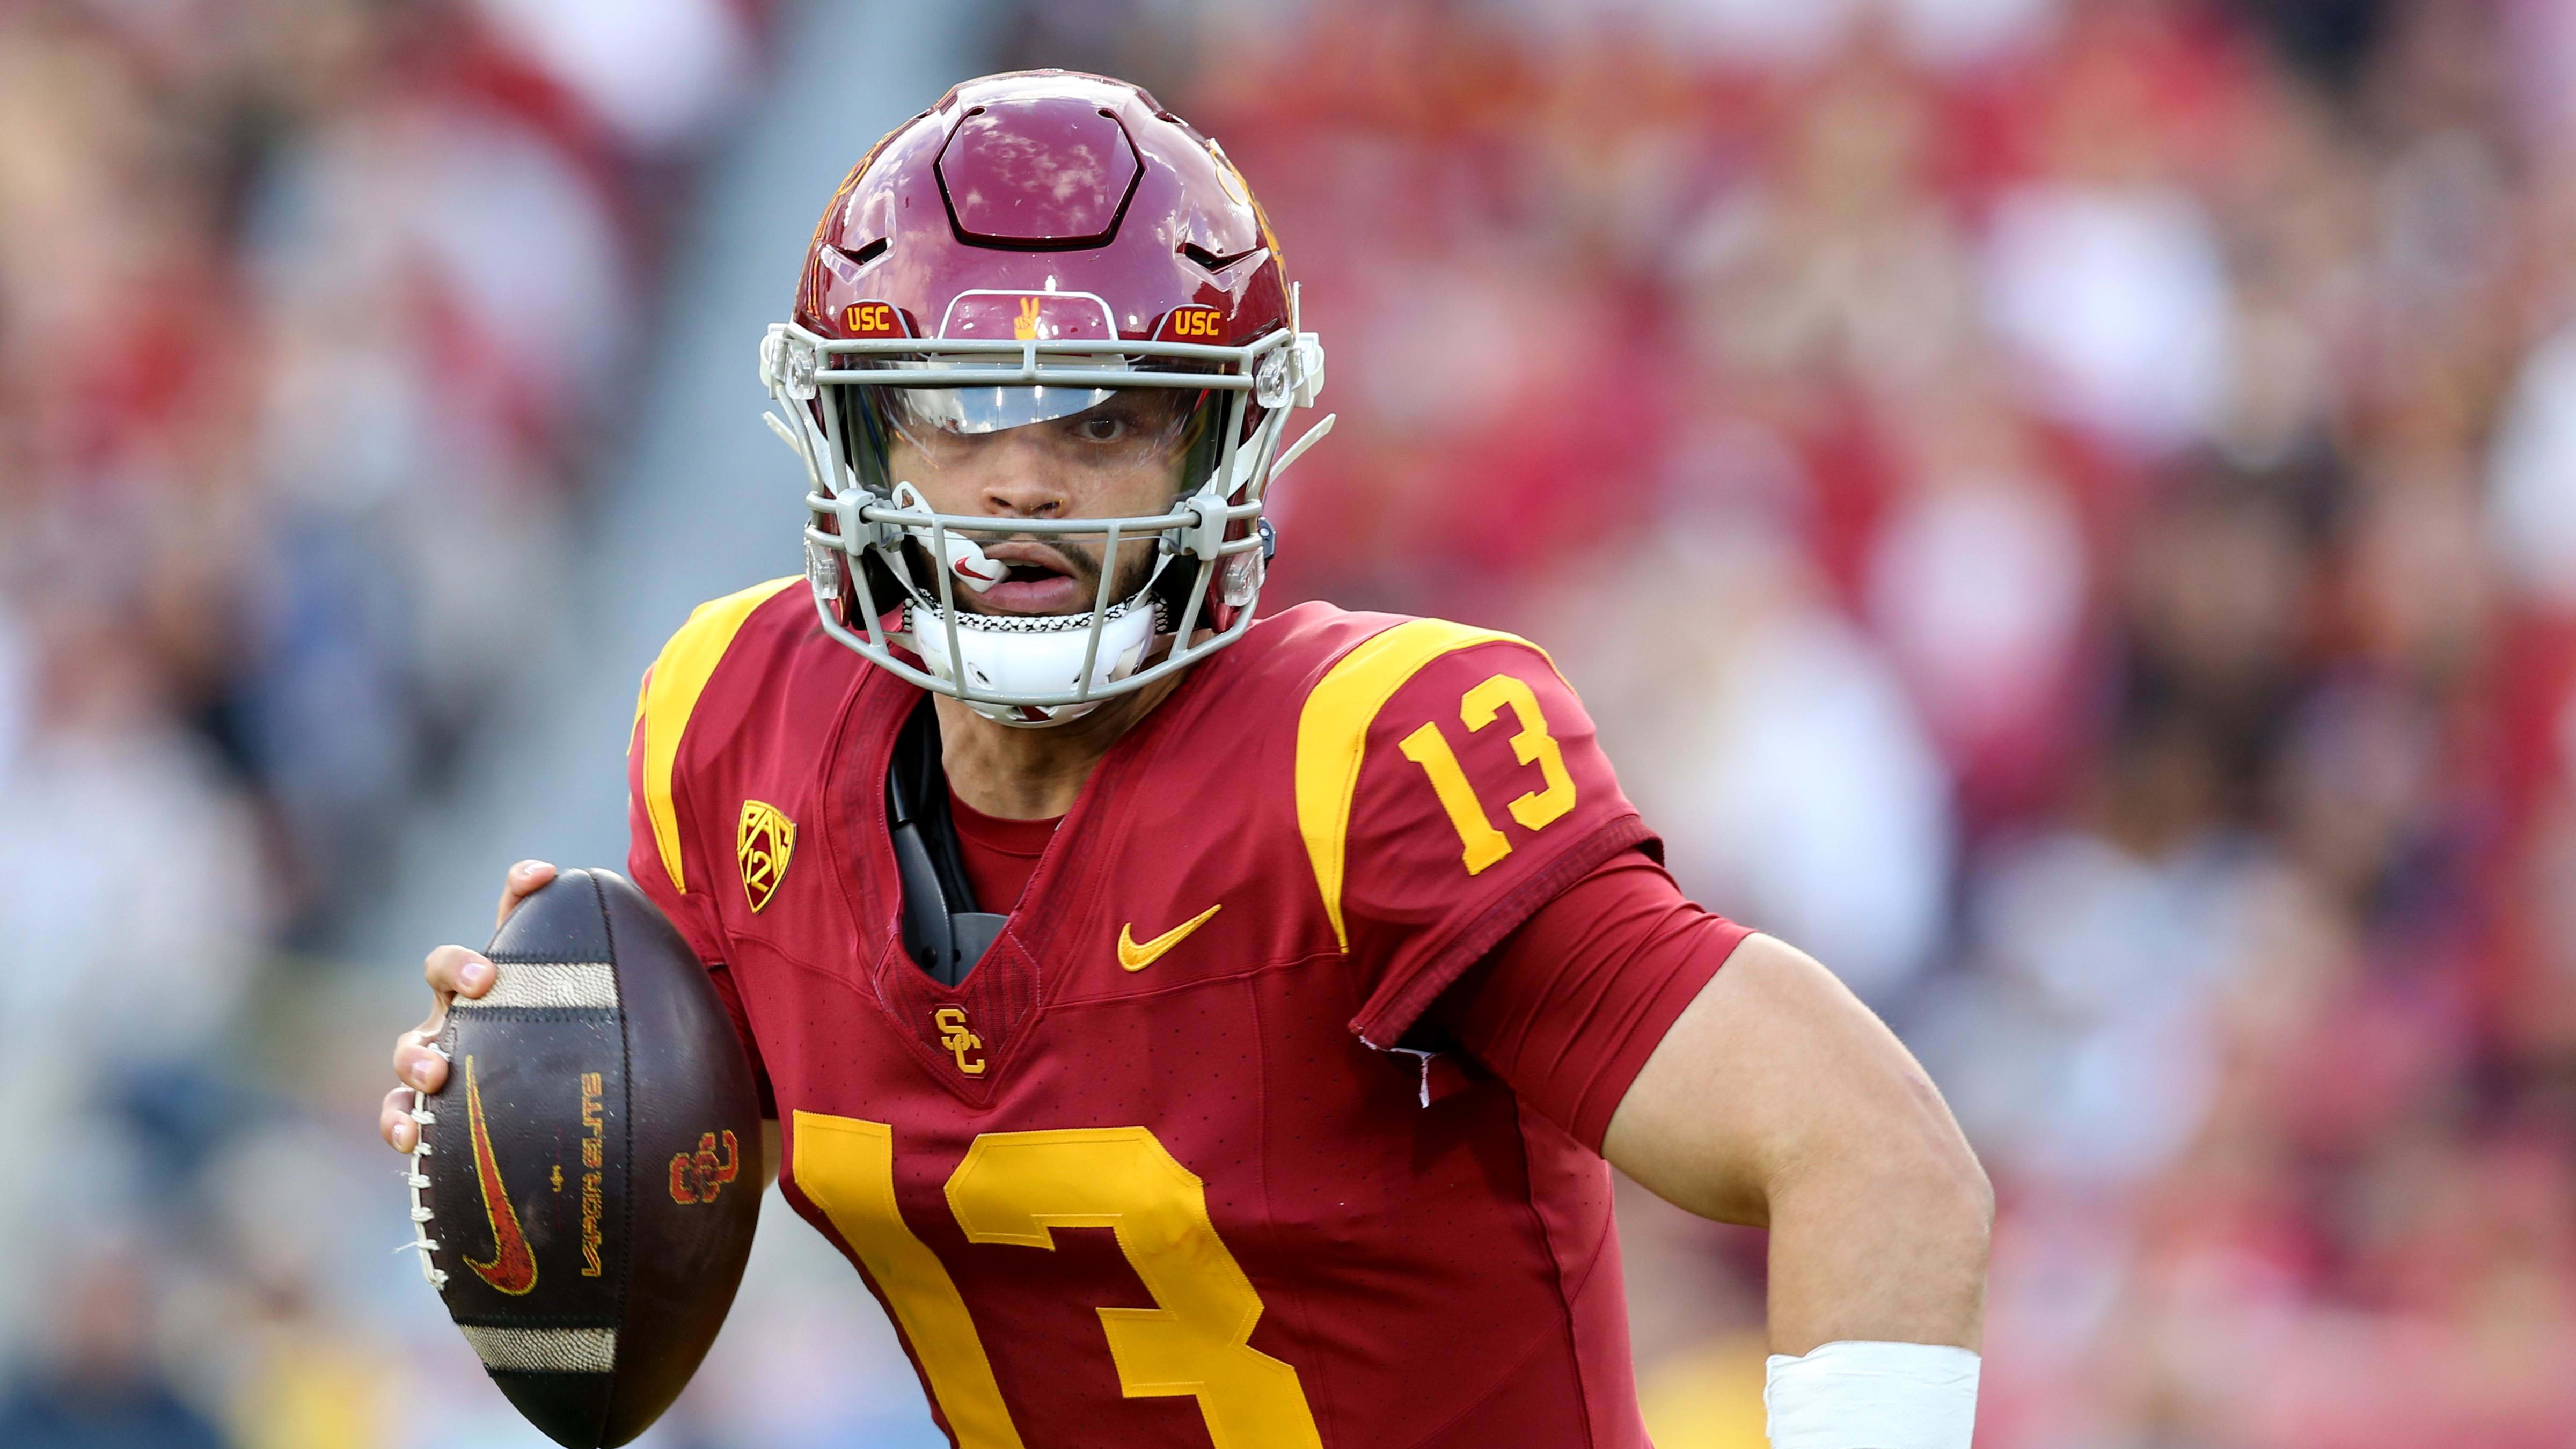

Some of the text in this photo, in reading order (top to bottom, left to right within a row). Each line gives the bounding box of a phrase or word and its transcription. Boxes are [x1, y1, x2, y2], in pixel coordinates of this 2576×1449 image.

[847, 306, 890, 331] USC
[1175, 311, 1220, 335] USC
[1397, 673, 1577, 876] 13
[739, 804, 794, 880] PAC
[745, 847, 773, 894] 12
[582, 1072, 603, 1169] ELITE
[793, 1109, 1324, 1449] 13
